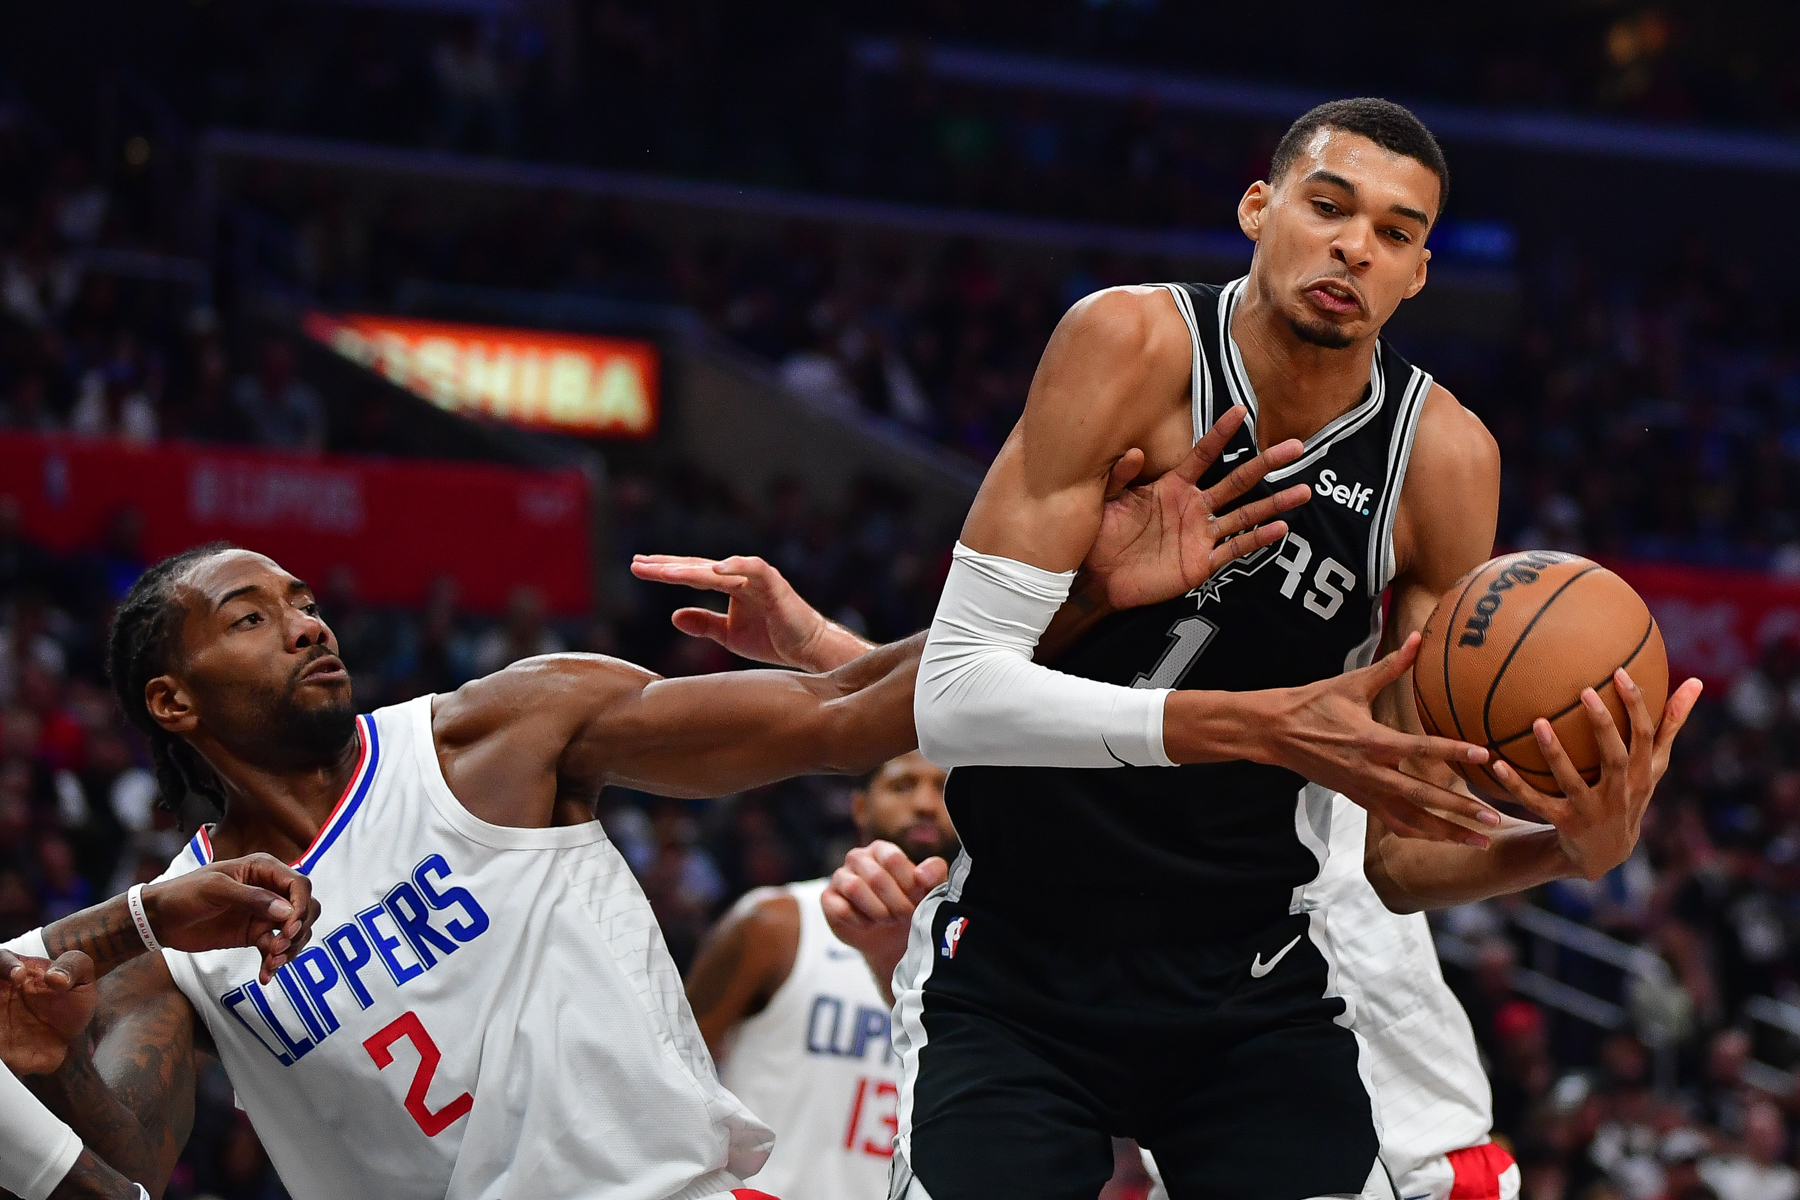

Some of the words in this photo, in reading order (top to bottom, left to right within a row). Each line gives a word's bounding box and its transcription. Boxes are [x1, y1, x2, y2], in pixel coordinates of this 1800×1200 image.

[1129, 614, 1220, 689] 1
[220, 853, 490, 1067] CLIPPERS
[362, 1010, 474, 1138] 2
[843, 1077, 898, 1161] 13
